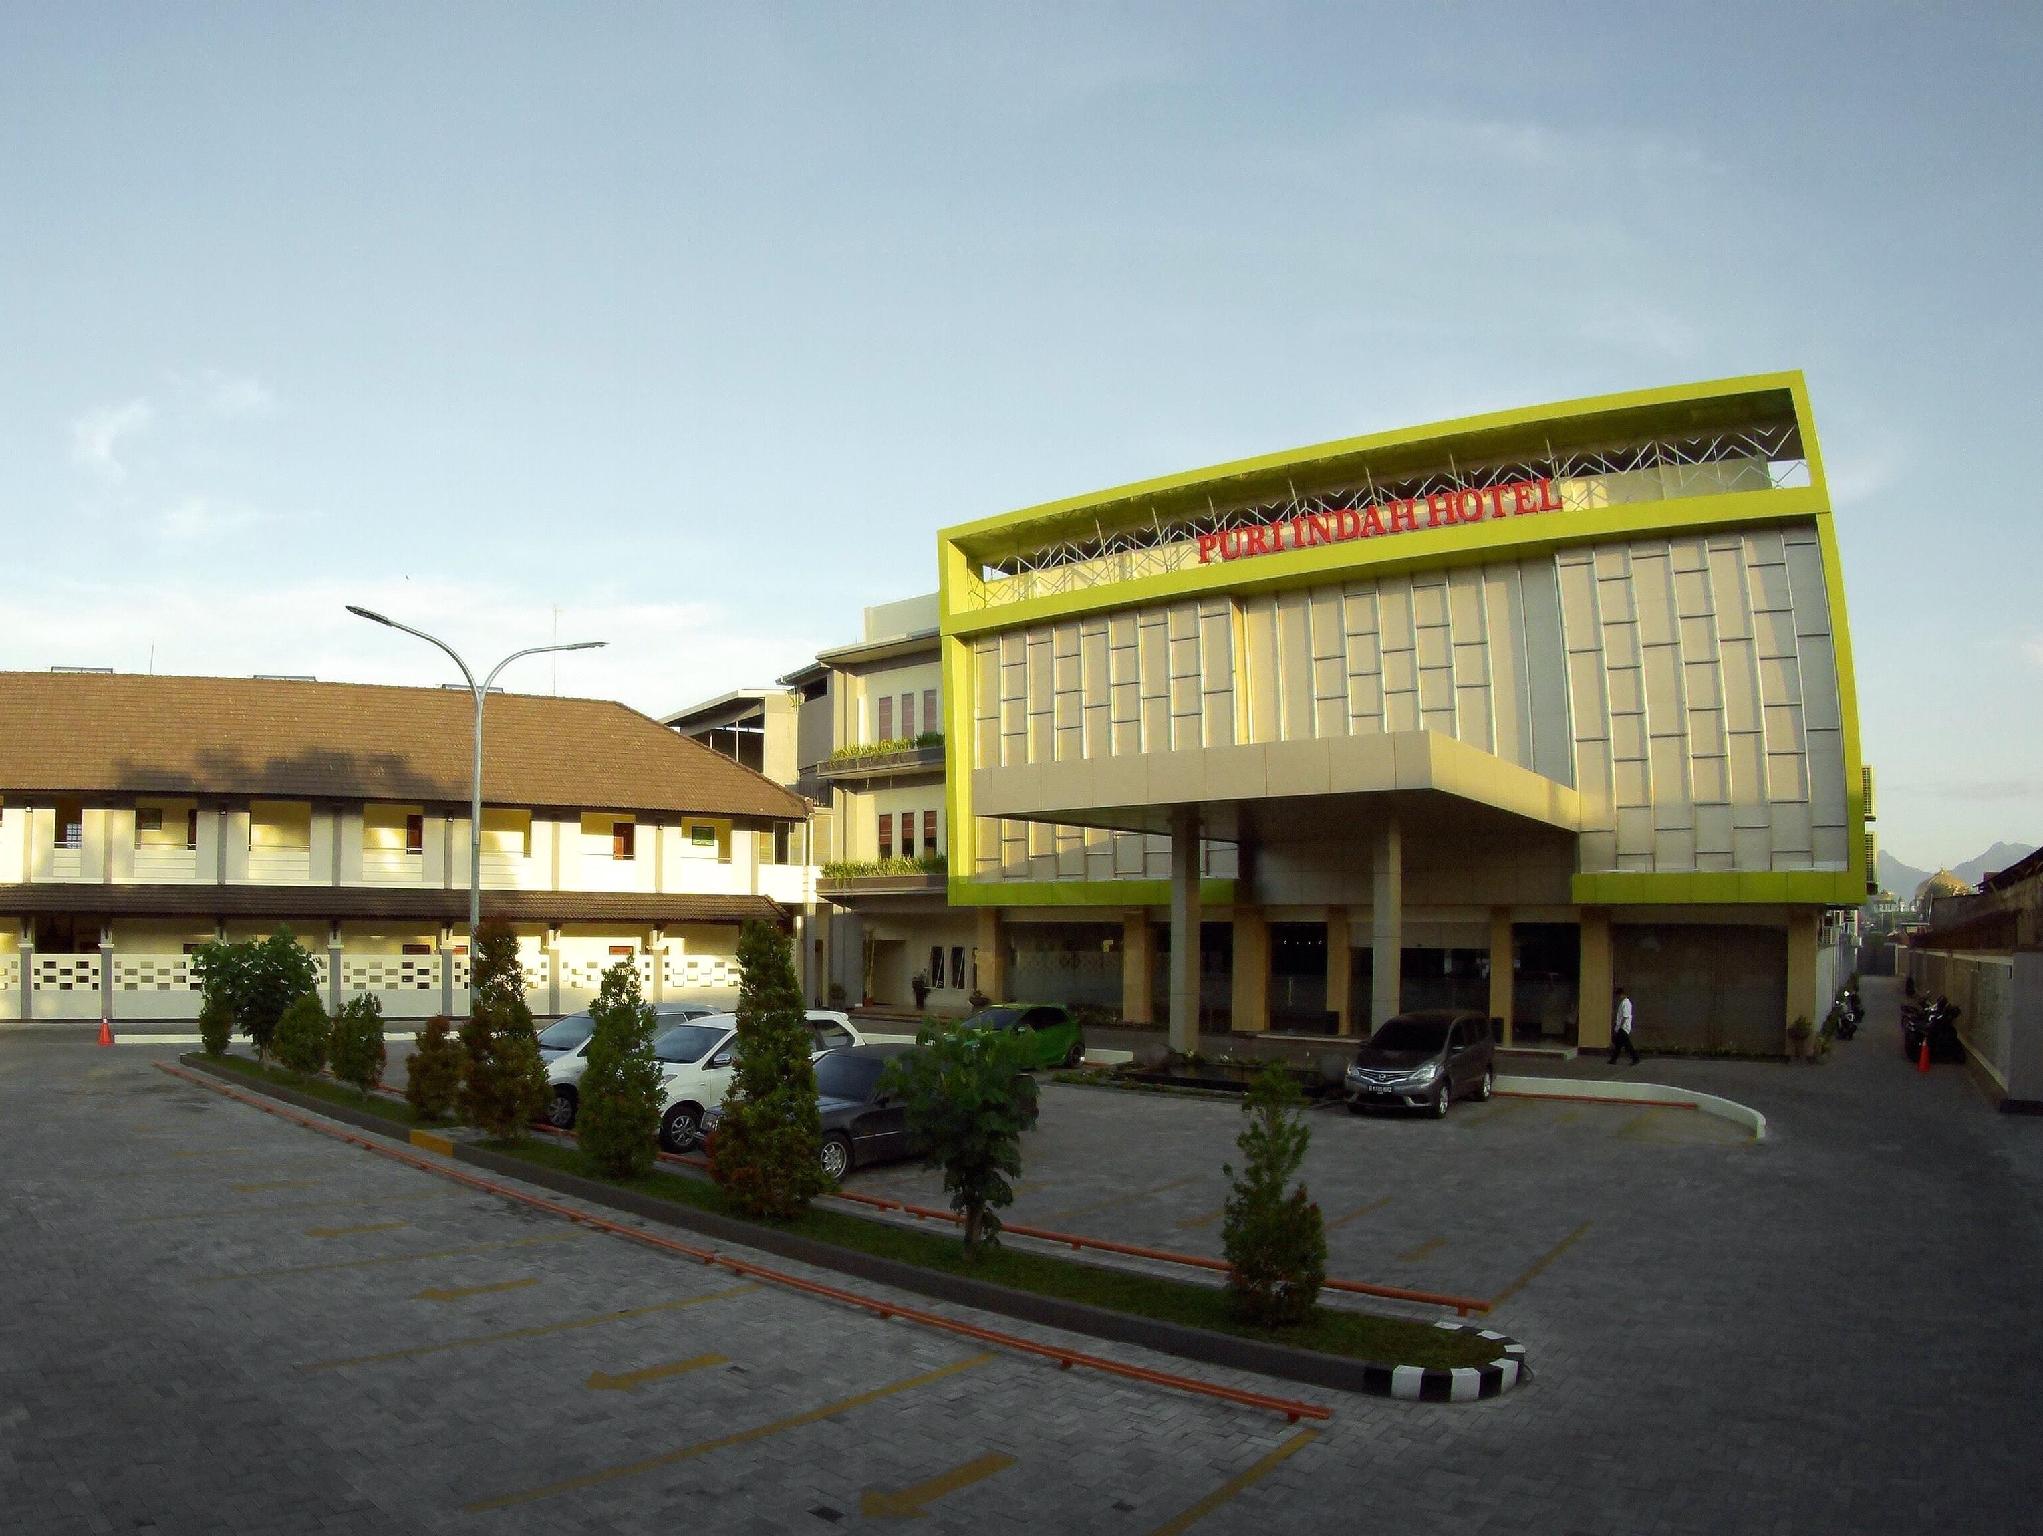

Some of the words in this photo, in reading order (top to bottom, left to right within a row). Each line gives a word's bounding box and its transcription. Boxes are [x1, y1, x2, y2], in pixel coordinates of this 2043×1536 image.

[1198, 521, 1285, 564] PURI
[1292, 498, 1419, 547] INDAH
[1427, 479, 1563, 527] HOTEL
